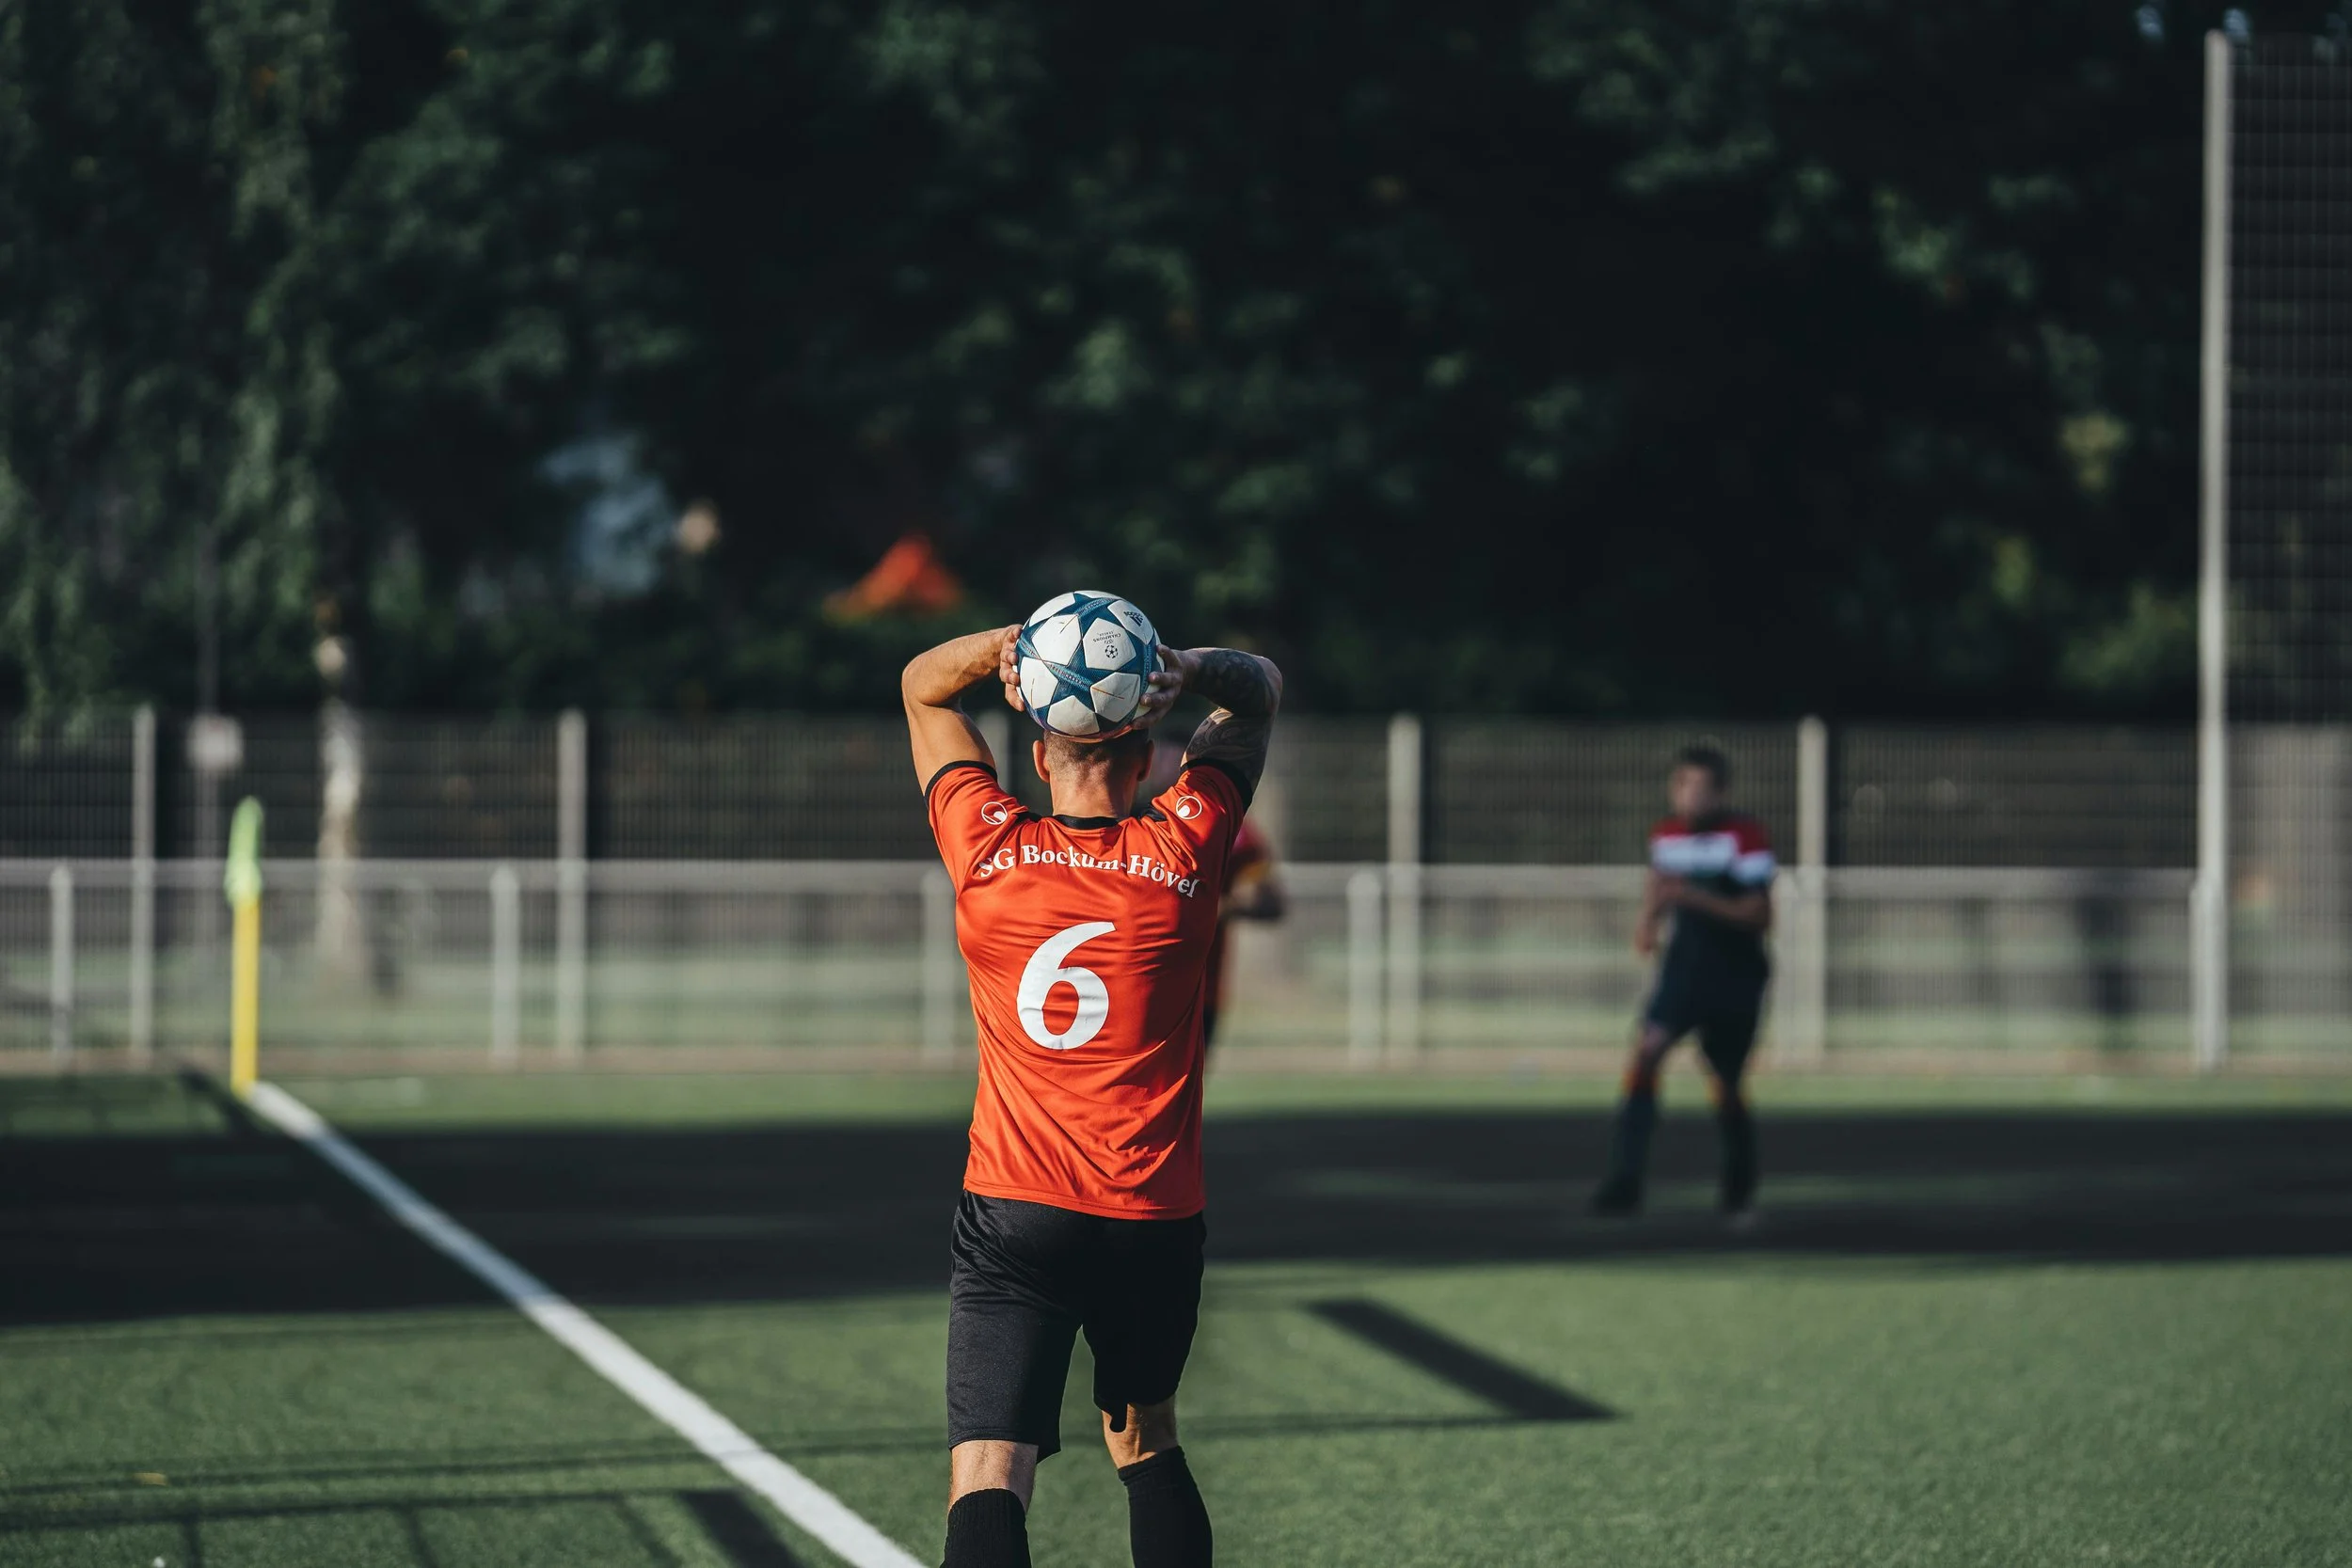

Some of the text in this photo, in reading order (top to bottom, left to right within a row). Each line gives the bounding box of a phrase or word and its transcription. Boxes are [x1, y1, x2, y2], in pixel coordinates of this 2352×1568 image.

[978, 845, 1200, 897] SG Bockum-Hövel
[1016, 921, 1117, 1050] 6
